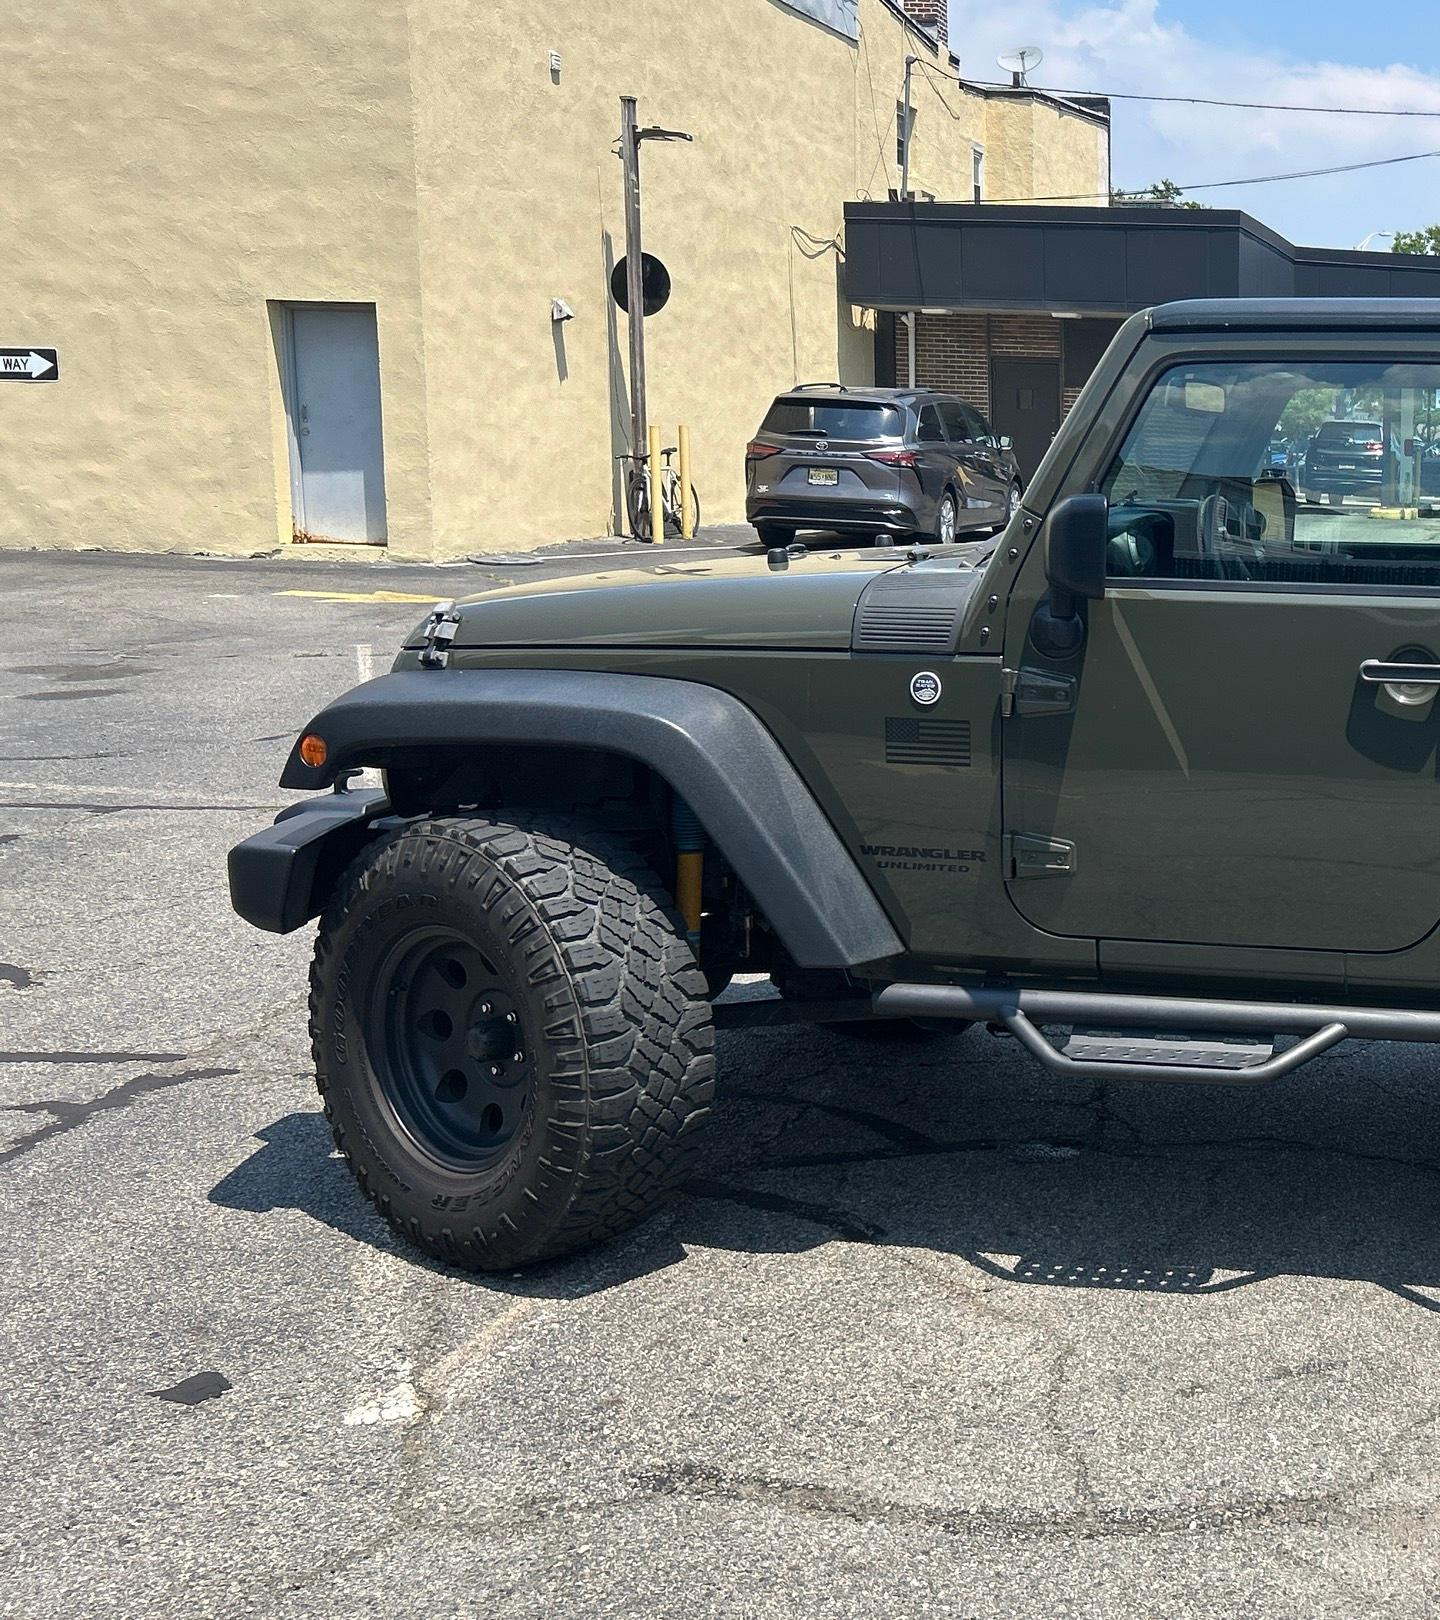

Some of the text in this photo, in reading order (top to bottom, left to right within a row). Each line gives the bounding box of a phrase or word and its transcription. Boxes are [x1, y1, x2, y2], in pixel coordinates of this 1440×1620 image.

[3, 358, 28, 370] WAY
[859, 844, 987, 862] WRANGLER
[877, 861, 970, 873] UNLIMITED
[334, 893, 441, 1066] GOOEAR
